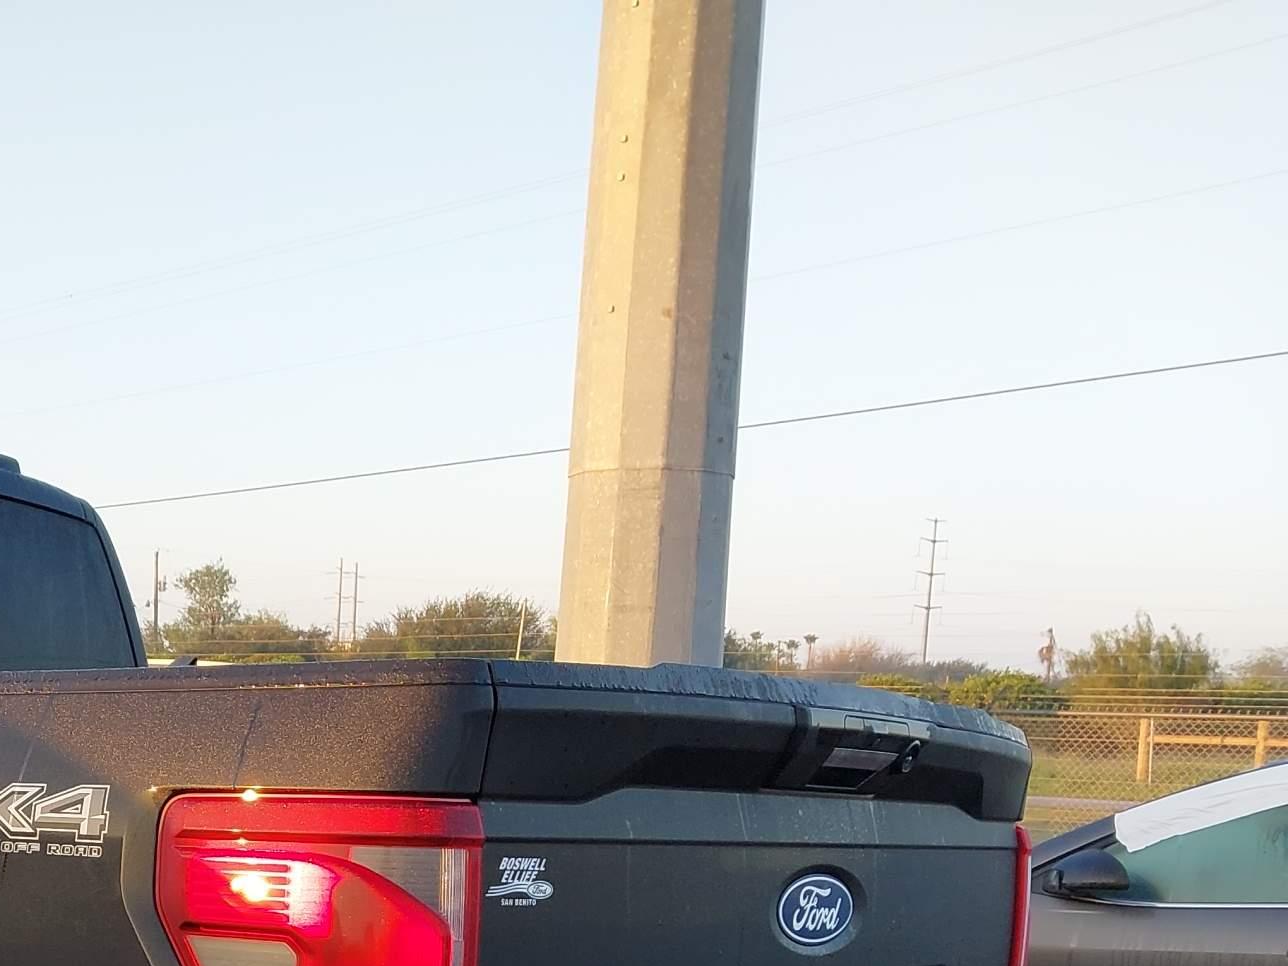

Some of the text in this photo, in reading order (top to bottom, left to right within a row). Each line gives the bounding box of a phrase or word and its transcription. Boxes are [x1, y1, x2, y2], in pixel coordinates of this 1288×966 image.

[0, 841, 102, 858] OFF ROAD
[499, 857, 547, 871] BOSWELL
[500, 898, 537, 907] SAN BENITO
[793, 885, 842, 932] Ford
